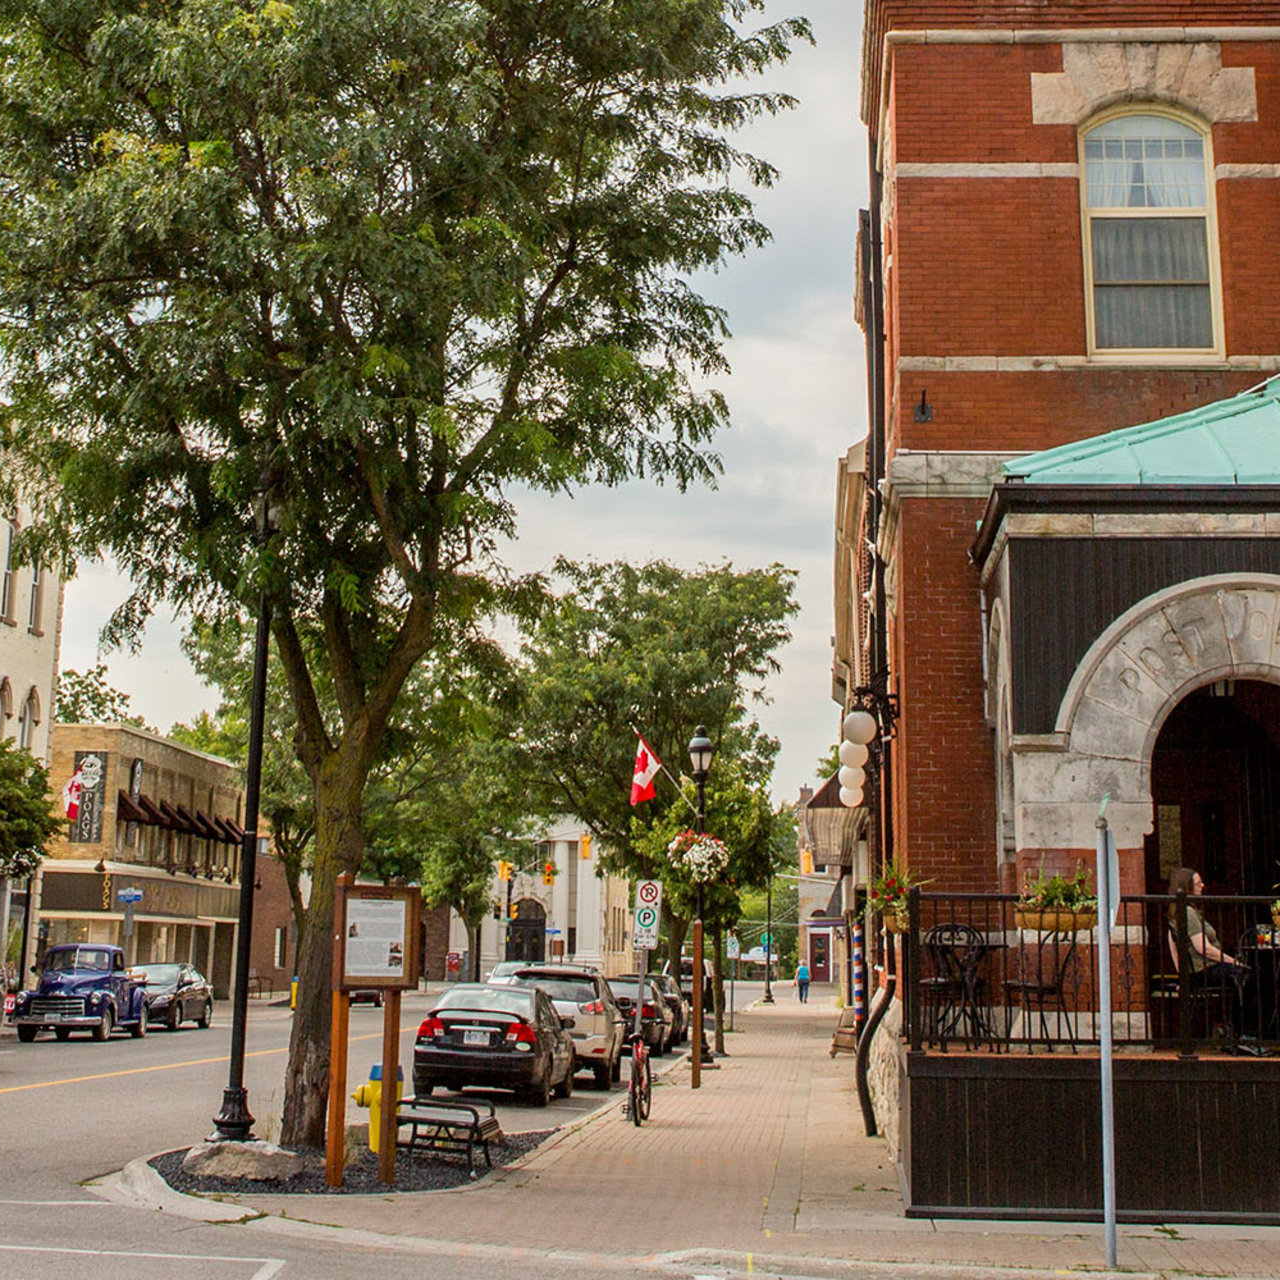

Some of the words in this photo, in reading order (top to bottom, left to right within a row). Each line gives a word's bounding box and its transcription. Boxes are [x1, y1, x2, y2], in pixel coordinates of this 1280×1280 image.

[1118, 615, 1205, 696] POST
[82, 792, 93, 839] POAGS
[643, 911, 651, 923] P
